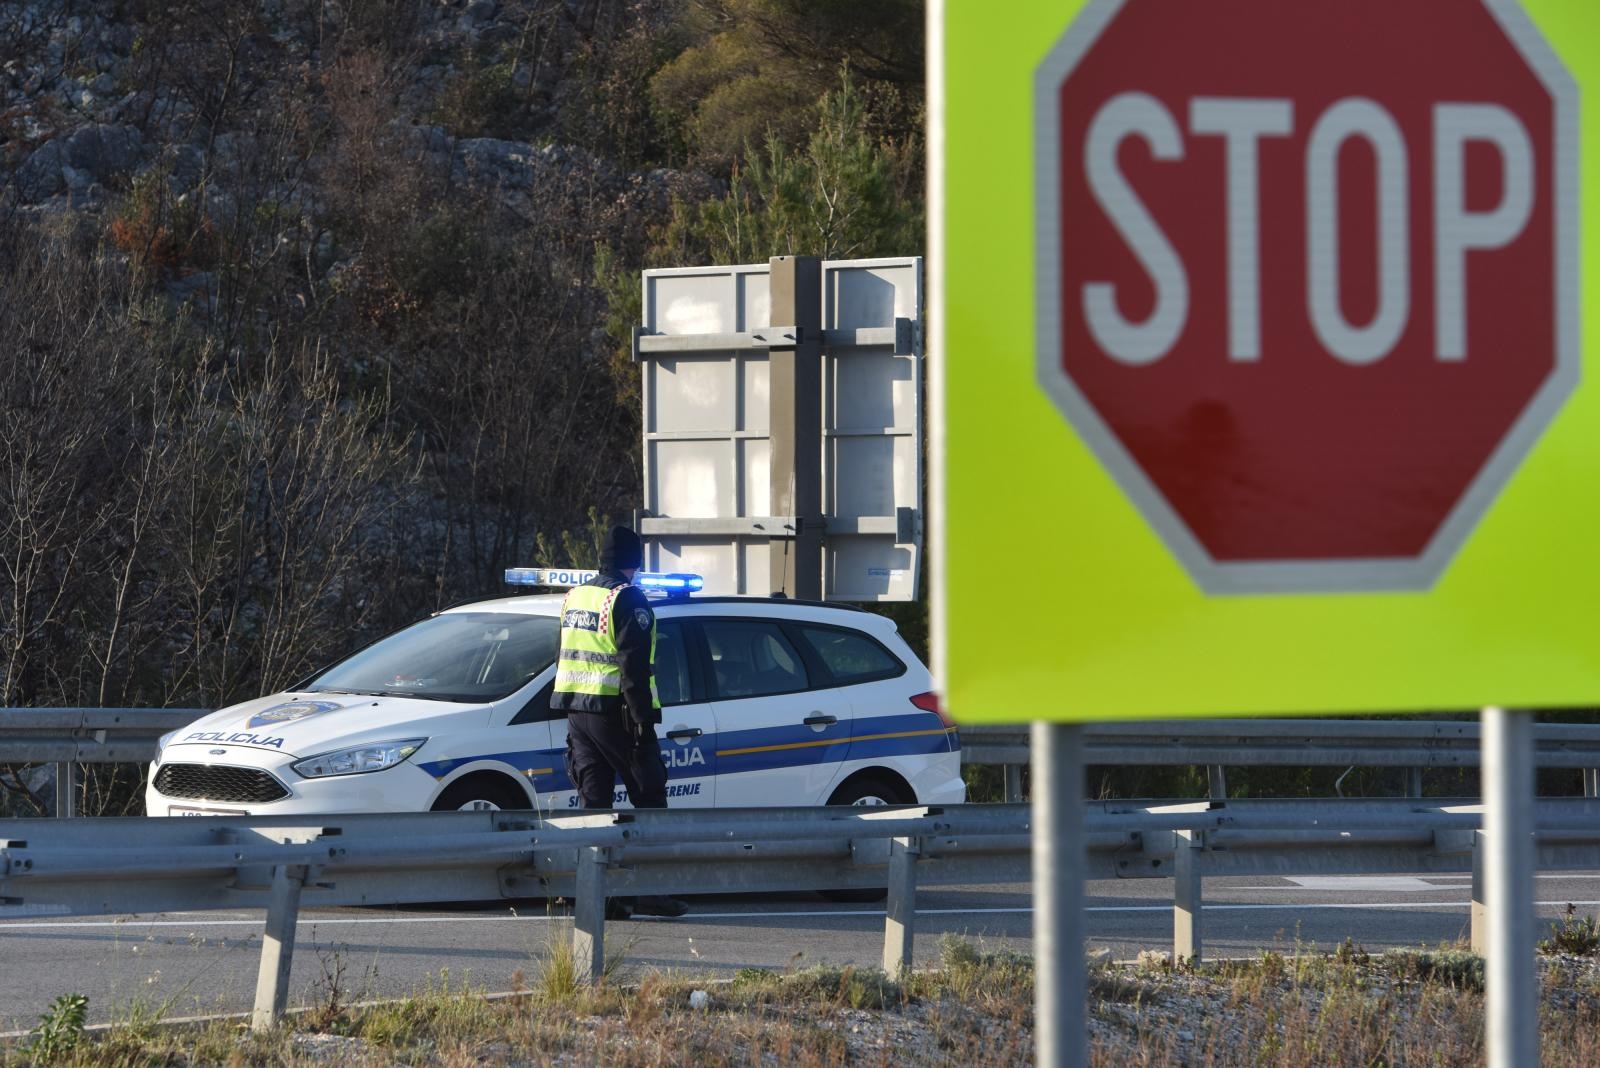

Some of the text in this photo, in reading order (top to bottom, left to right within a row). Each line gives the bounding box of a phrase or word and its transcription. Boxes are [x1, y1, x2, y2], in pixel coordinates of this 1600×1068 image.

[1082, 91, 1536, 366] STOP
[549, 571, 594, 585] POLIC
[183, 731, 285, 748] POLICIJA
[660, 746, 706, 769] CIJA
[664, 782, 702, 797] ERENJE
